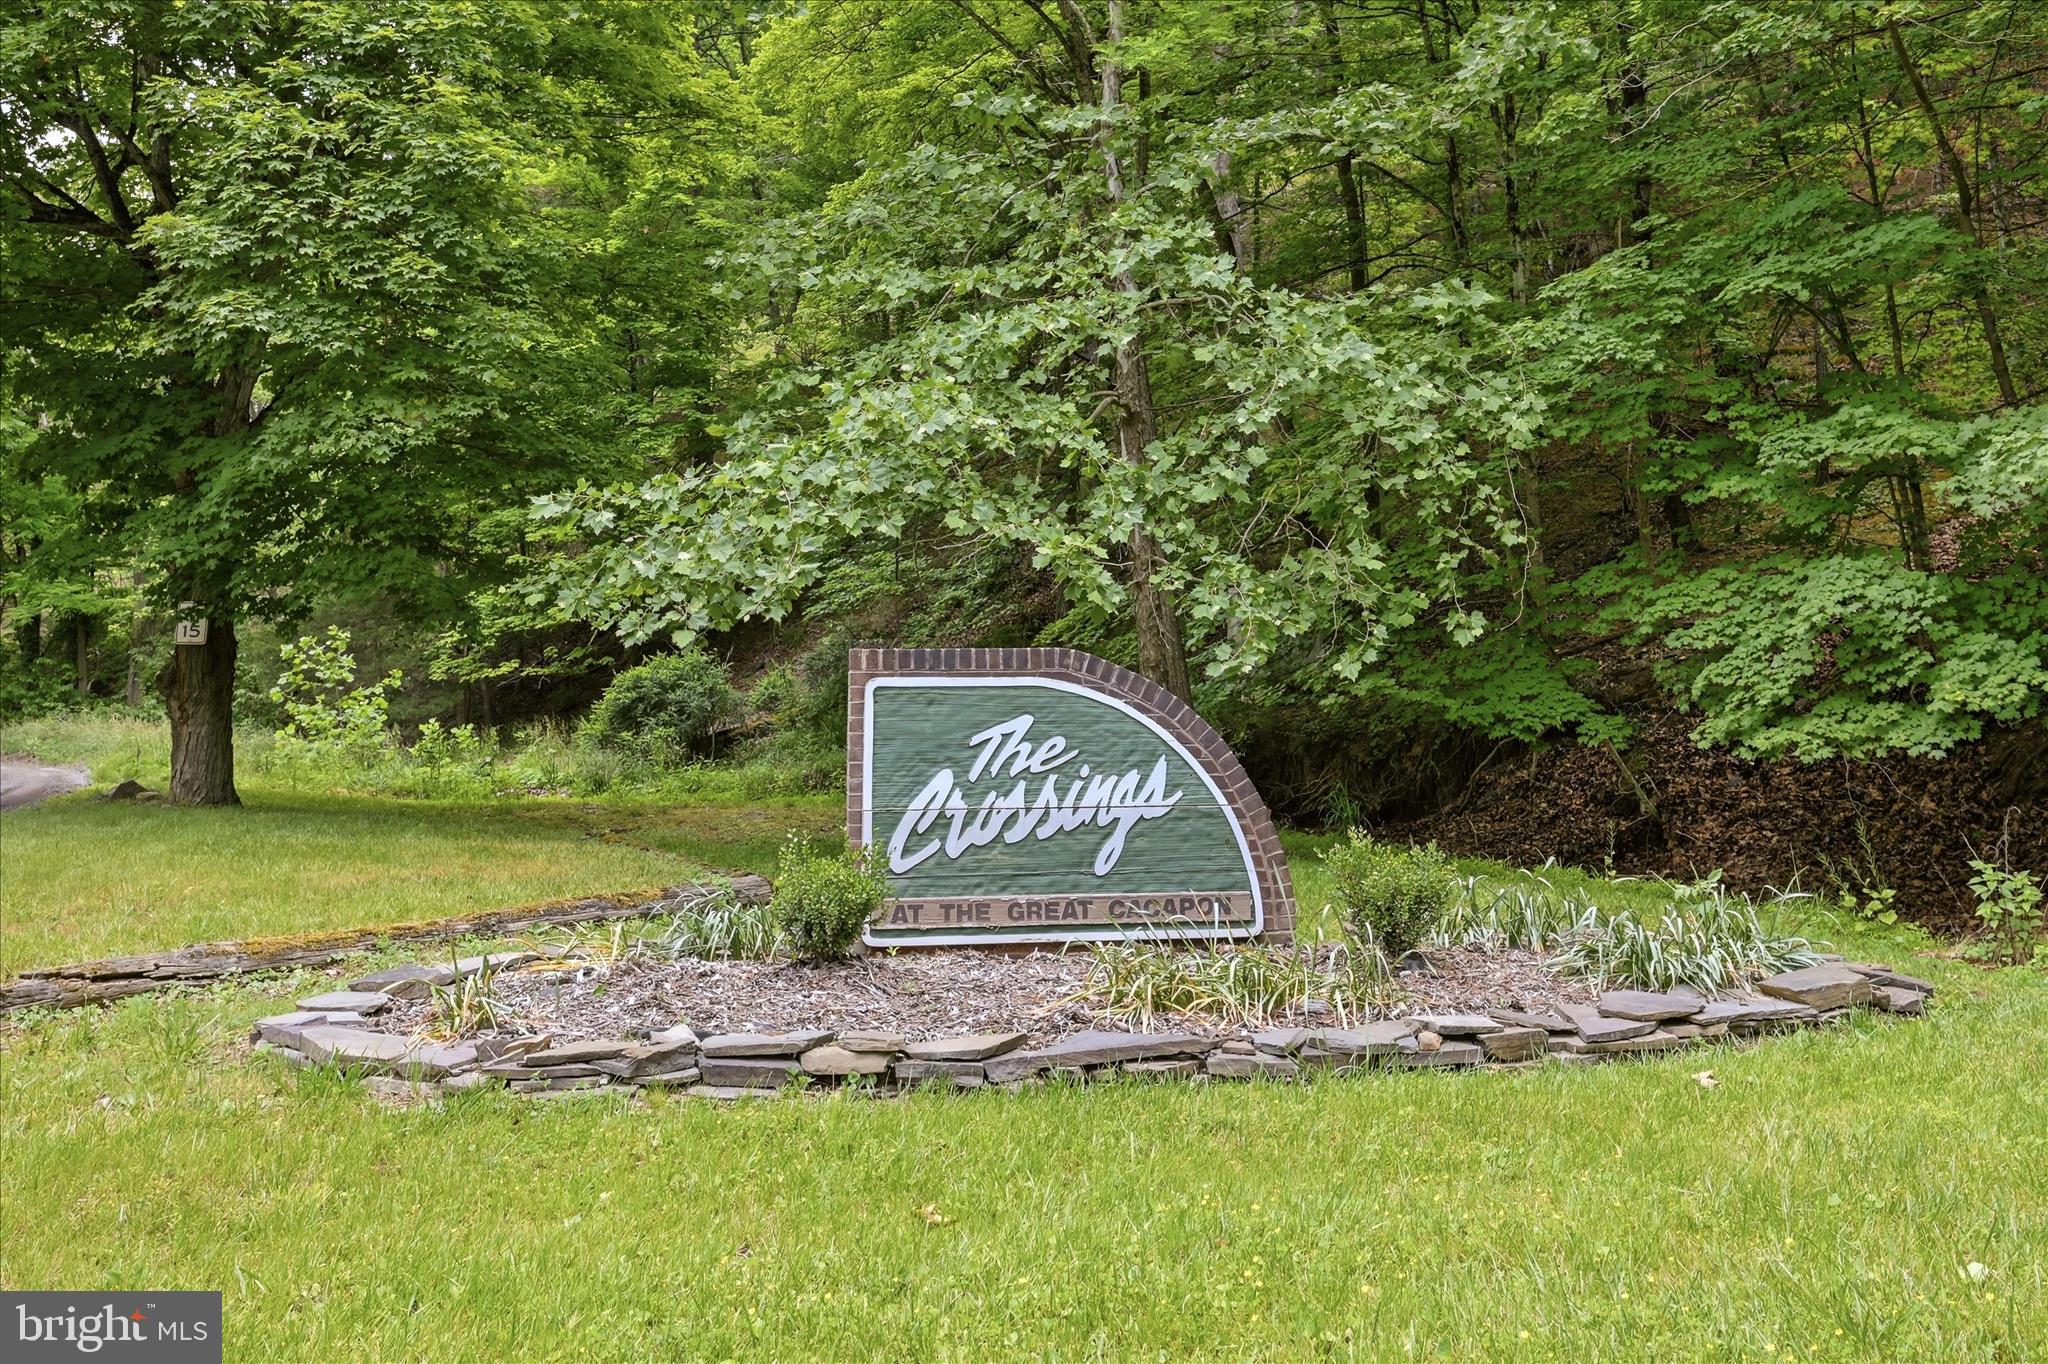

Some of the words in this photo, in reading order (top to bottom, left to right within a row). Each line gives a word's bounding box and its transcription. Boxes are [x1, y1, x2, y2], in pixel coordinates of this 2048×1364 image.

[182, 624, 200, 638] 15
[968, 714, 1079, 783] The
[889, 754, 1184, 876] Crossings
[890, 903, 925, 924] AT
[939, 902, 991, 923] THE
[1007, 900, 1093, 921] GREAT
[1108, 896, 1232, 918] CACAPON
